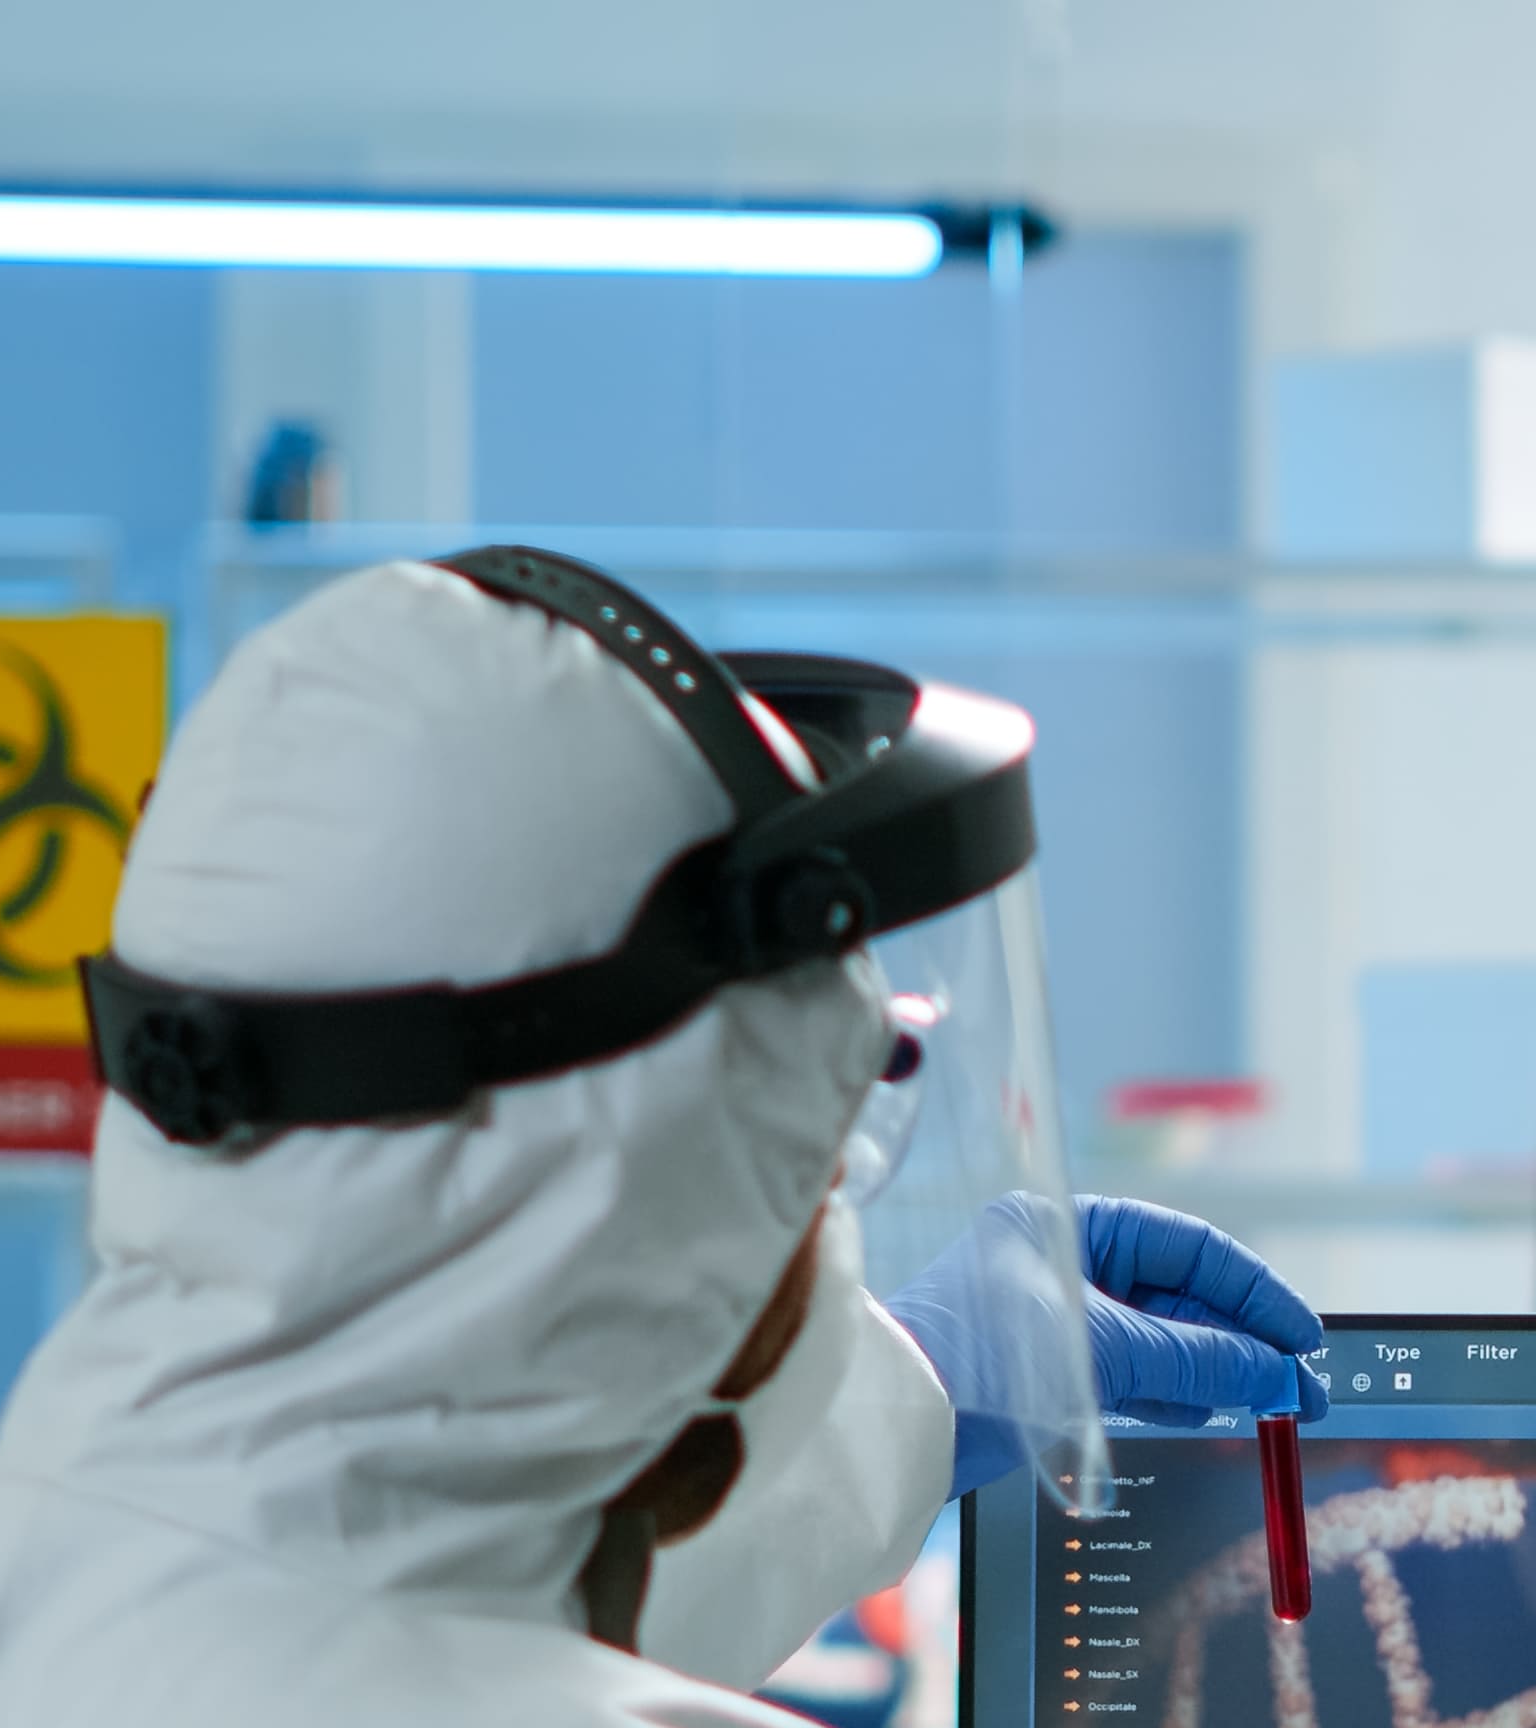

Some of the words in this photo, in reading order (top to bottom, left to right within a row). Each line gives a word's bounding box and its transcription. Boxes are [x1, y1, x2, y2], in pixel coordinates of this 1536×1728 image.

[1375, 1344, 1421, 1362] Type
[1467, 1344, 1518, 1360] Filter
[1089, 1573, 1131, 1583] Mascella
[1089, 1605, 1139, 1615] Mandibola
[1089, 1637, 1140, 1648] Nasale_DX
[1088, 1670, 1139, 1681] Nasale_SX
[1087, 1701, 1137, 1712] Occipitale
